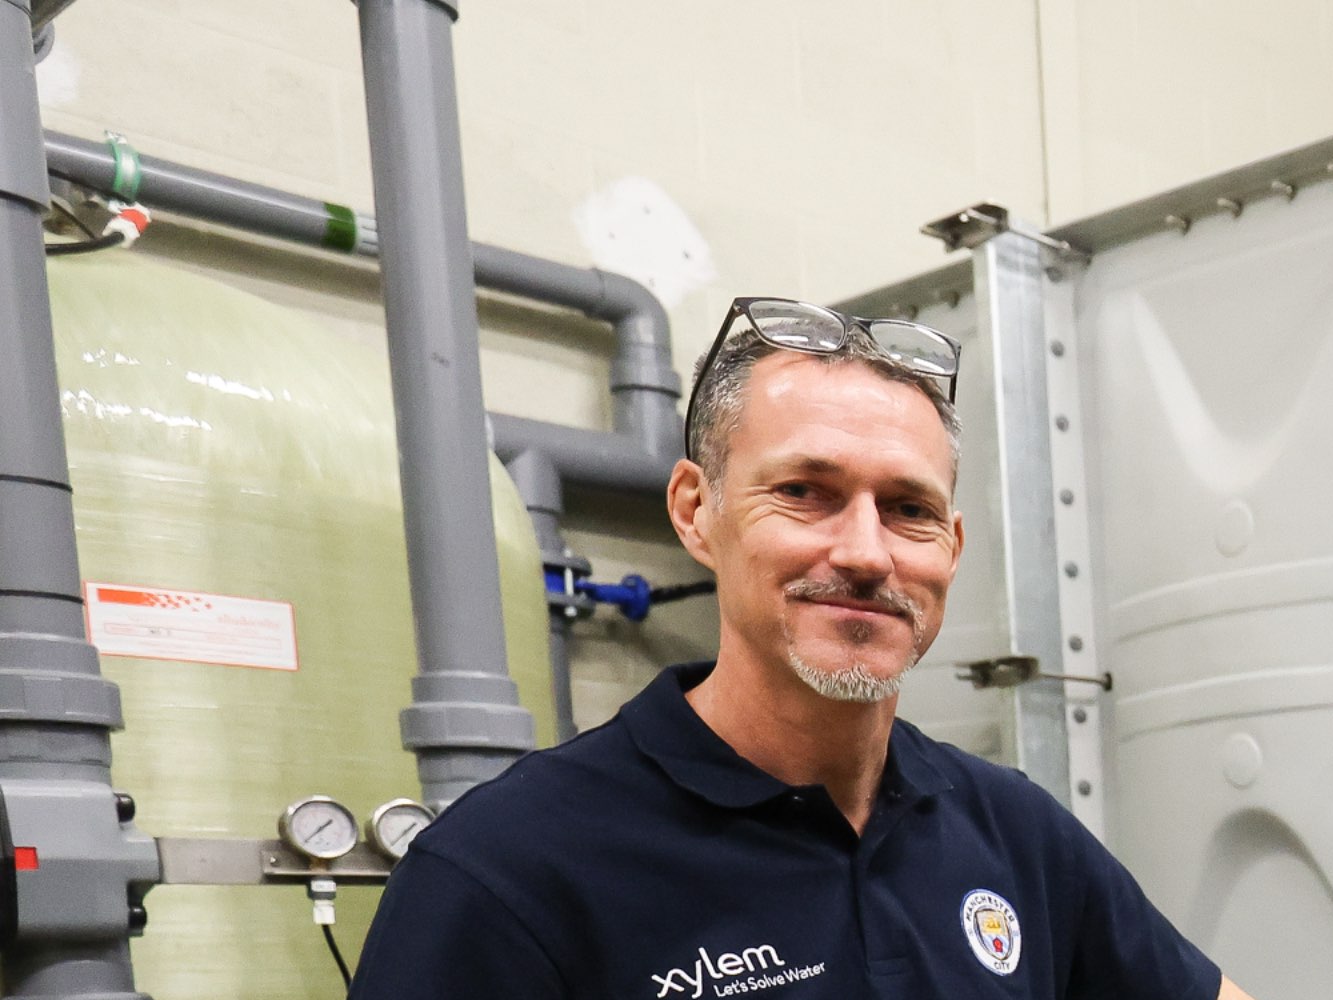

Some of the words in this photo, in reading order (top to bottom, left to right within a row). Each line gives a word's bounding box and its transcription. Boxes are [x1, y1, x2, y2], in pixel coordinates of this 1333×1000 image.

[651, 944, 786, 999] xylem
[713, 980, 749, 997] Let's
[747, 974, 786, 991] Solve
[782, 962, 826, 983] Water
